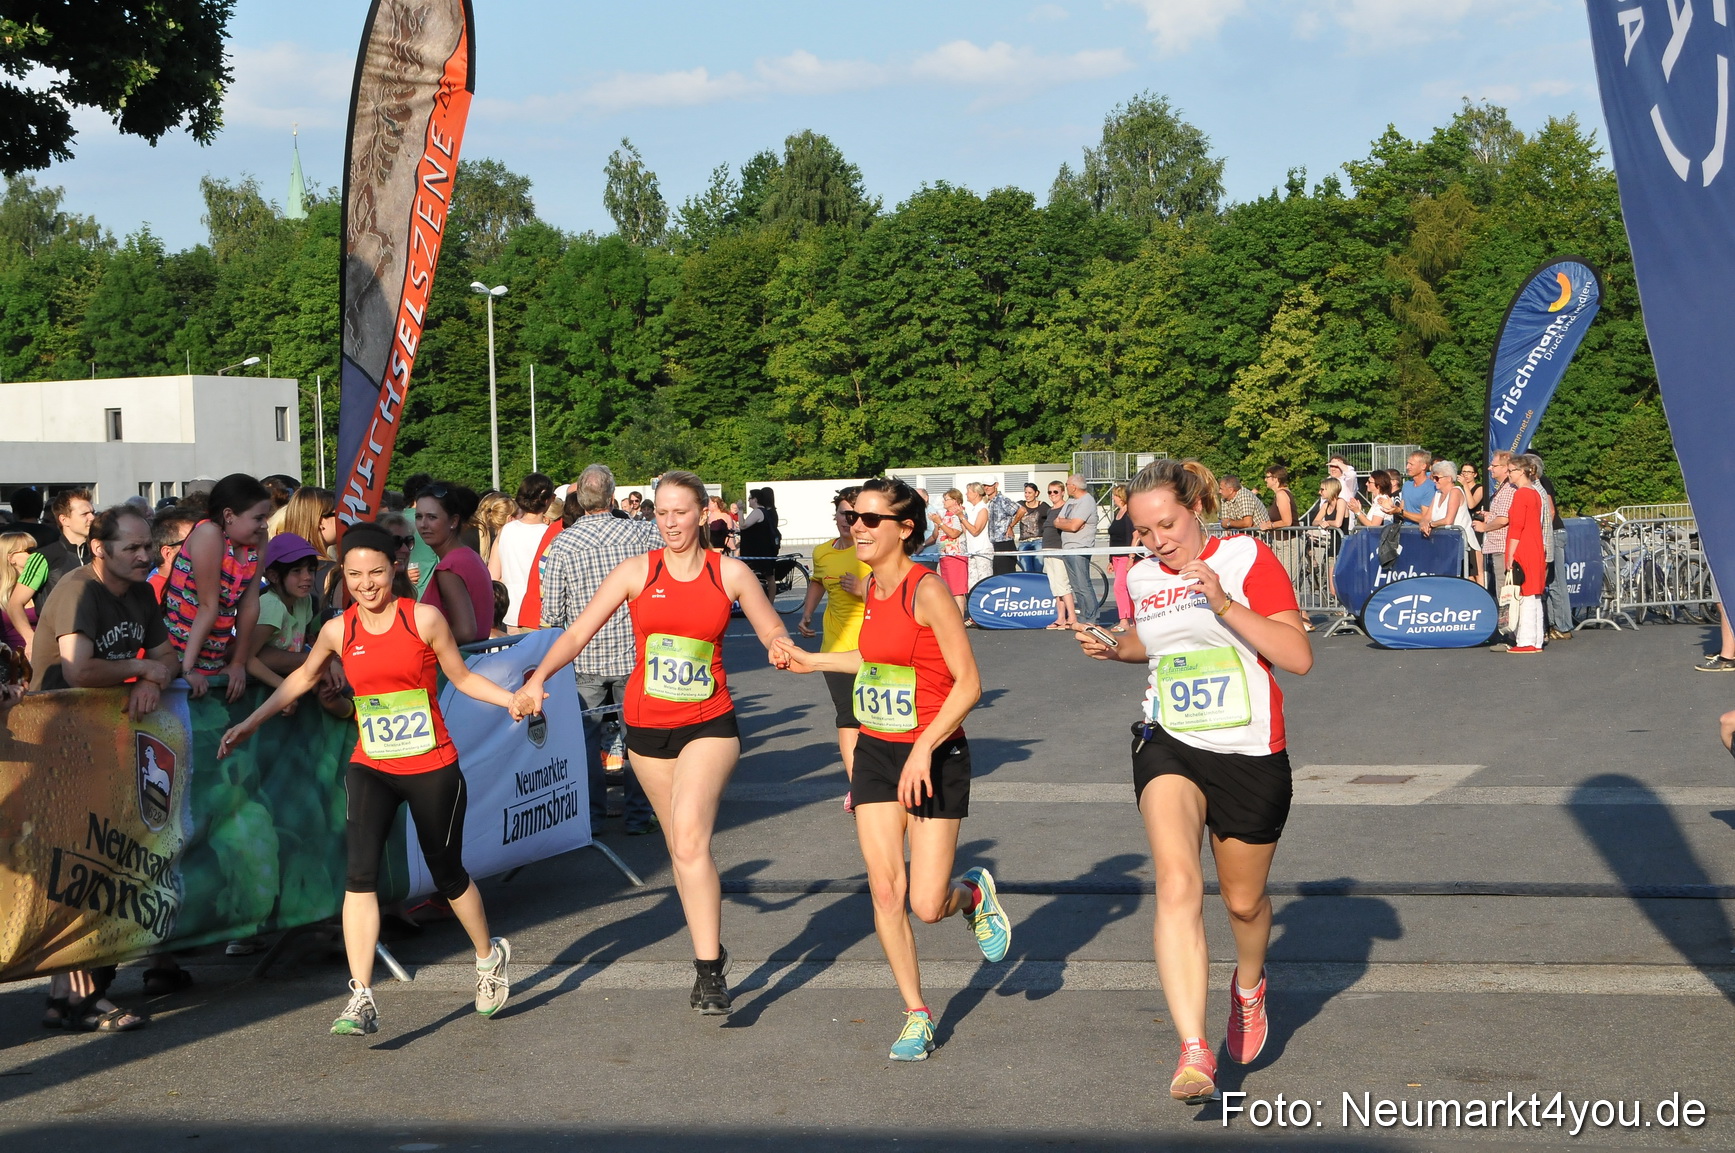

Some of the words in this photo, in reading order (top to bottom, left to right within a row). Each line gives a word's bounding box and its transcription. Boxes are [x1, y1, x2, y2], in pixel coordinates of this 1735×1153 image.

[1543, 331, 1565, 361] Druck
[1562, 315, 1577, 333] und
[1494, 314, 1568, 425] Frischmann
[1000, 609, 1055, 618] AUTOMOBILE
[1398, 607, 1481, 626] Fischer
[1406, 624, 1476, 634] AUTOMOBILE
[648, 656, 712, 686] 1304
[856, 686, 912, 716] 1315
[1170, 676, 1230, 712] 957
[362, 712, 430, 742] 1322
[515, 757, 568, 798] Neumarkter
[503, 785, 578, 846] Lammsbräu
